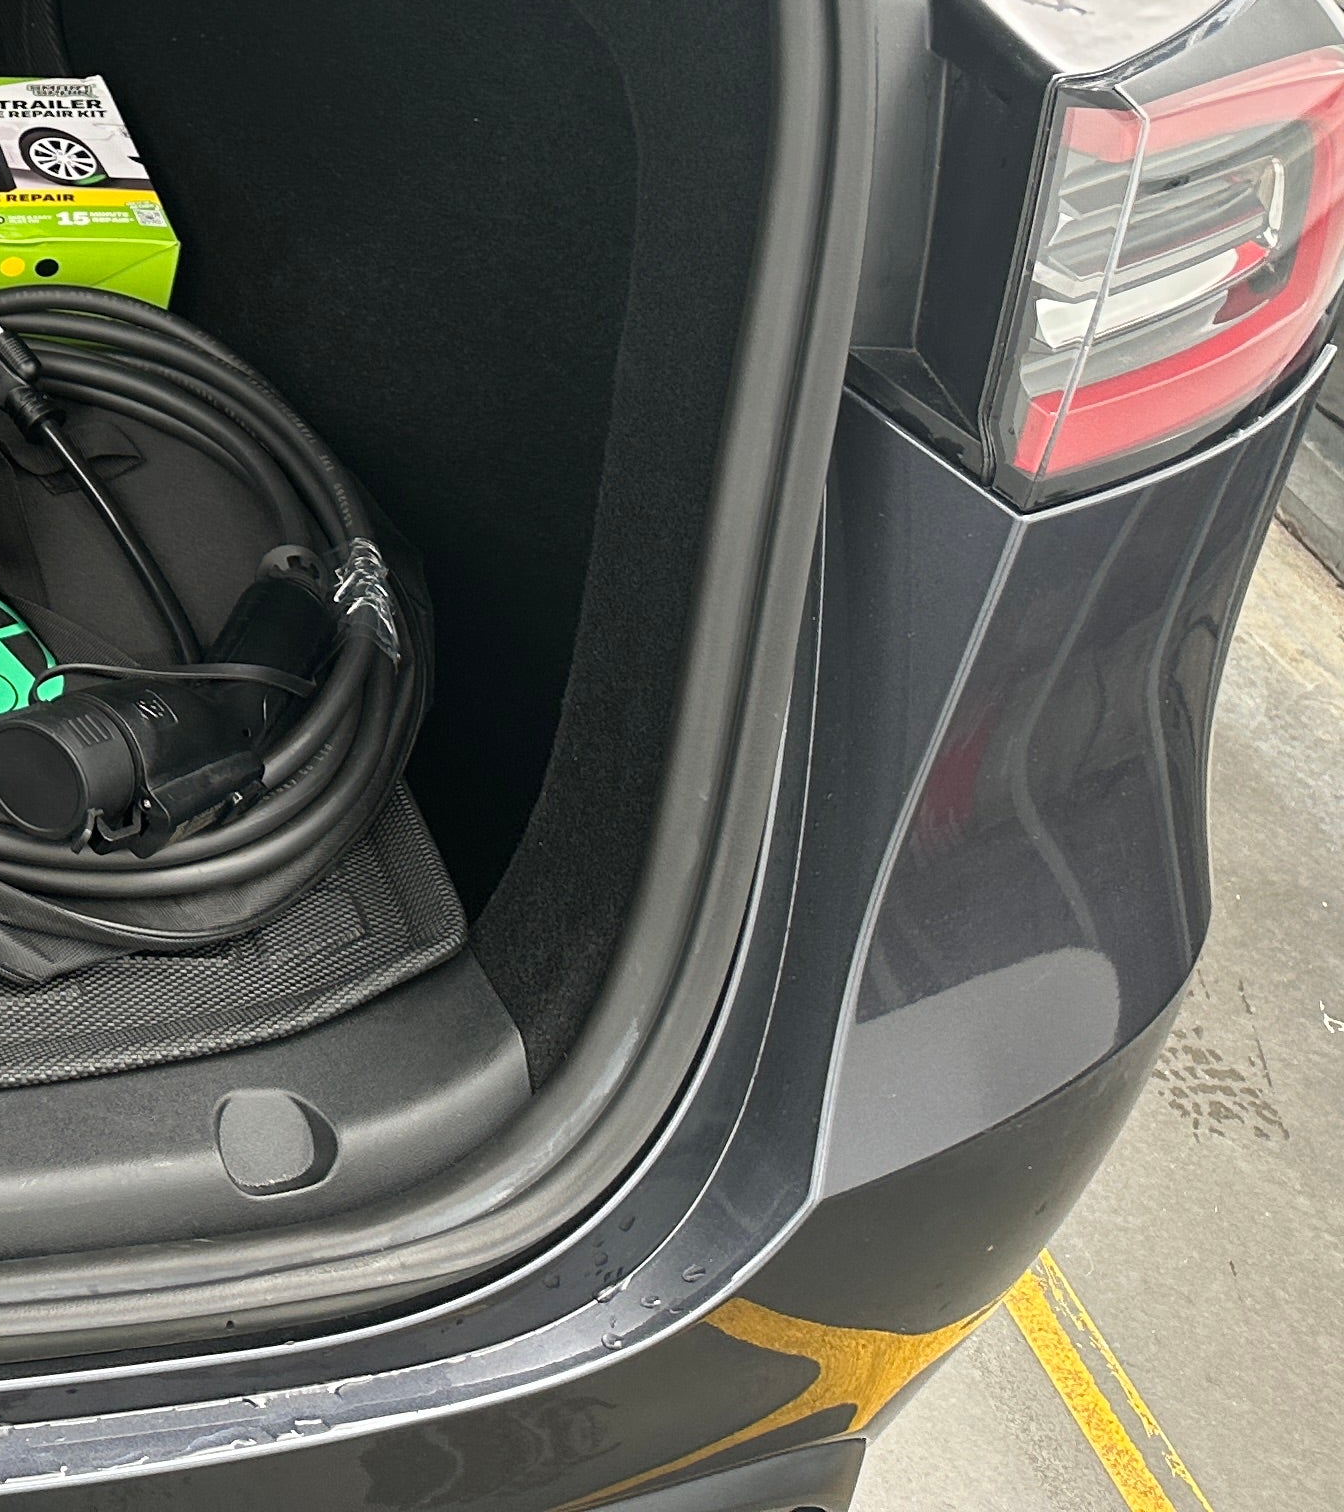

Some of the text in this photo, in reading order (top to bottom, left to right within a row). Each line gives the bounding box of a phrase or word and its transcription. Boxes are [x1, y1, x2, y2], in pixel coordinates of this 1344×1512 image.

[8, 110, 74, 119] REPAIR
[77, 109, 108, 118] KIT
[6, 193, 76, 203] REPAIR
[55, 210, 91, 227] 15
